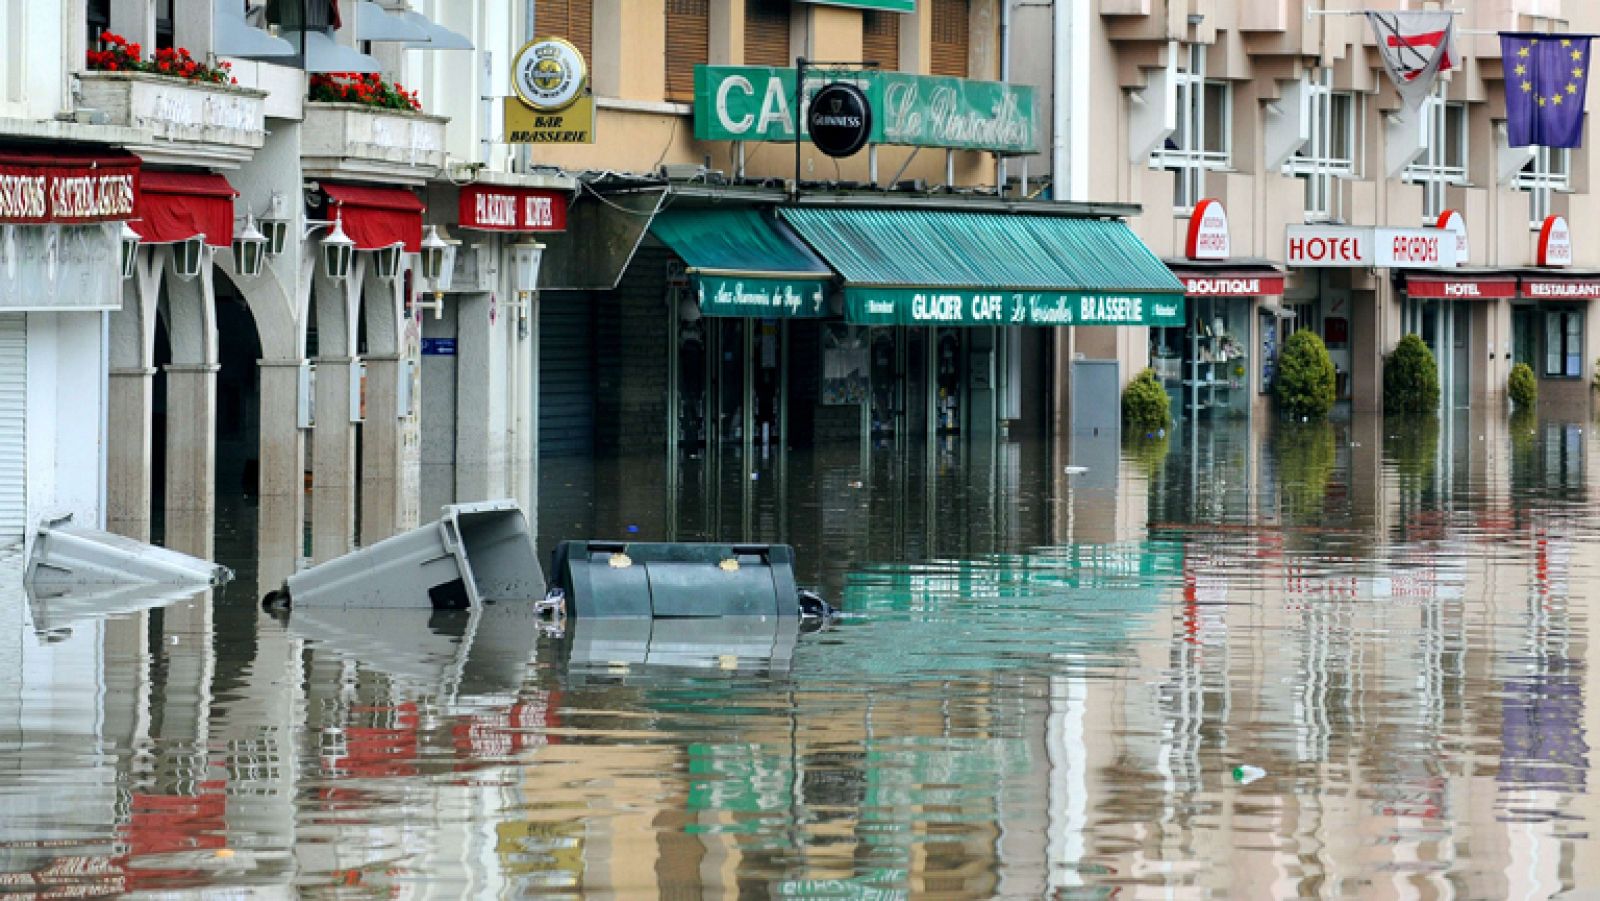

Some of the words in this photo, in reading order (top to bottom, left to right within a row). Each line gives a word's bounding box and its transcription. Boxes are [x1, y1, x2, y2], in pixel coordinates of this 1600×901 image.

[534, 116, 564, 128] BAR
[814, 113, 861, 128] GUINNESS
[510, 130, 587, 142] BRASSERIE
[1289, 237, 1362, 261] HOTEL
[1393, 235, 1438, 262] ARCADES
[1187, 279, 1260, 293] BOUTIQUE
[1445, 283, 1481, 296] HOTEL
[1530, 283, 1600, 297] RESTAURANT
[912, 294, 962, 320] GLACIER
[971, 295, 1003, 320] CAFE
[1080, 296, 1142, 321] BRASSERIE
